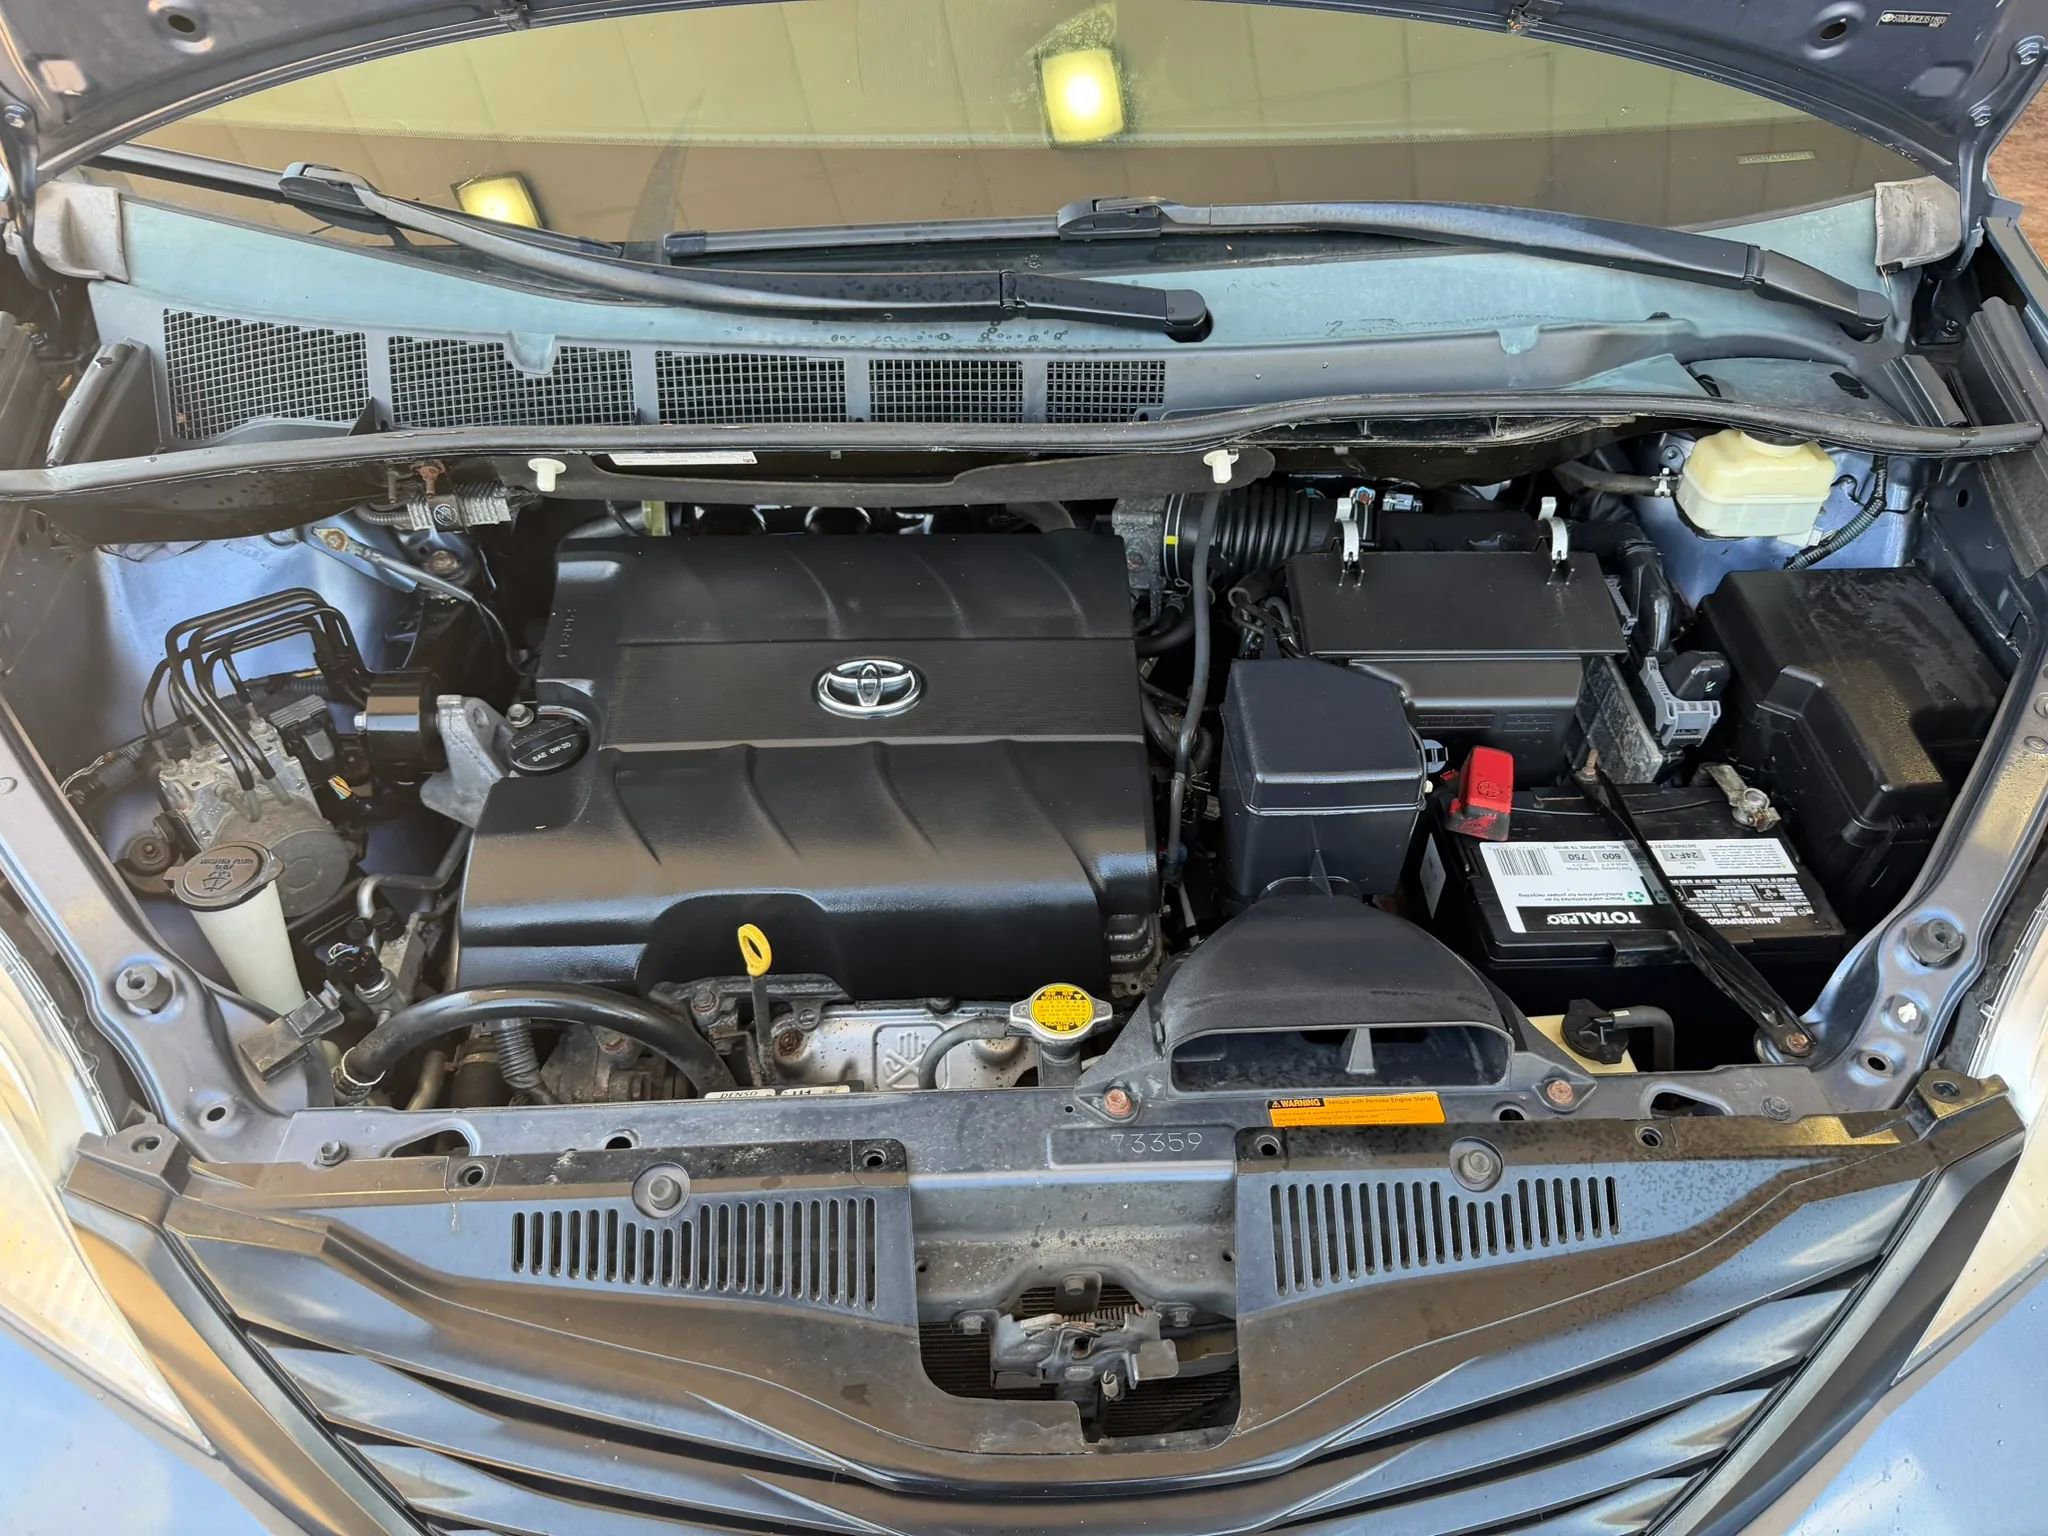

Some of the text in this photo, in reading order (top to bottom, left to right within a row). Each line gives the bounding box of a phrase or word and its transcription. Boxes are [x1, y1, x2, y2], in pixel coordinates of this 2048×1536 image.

[532, 742, 572, 762] SAE 0W-20
[1547, 911, 1641, 925] TOTALPRO
[1280, 1099, 1321, 1107] WARNING
[1391, 1096, 1412, 1104] Engine
[1110, 1132, 1203, 1153] 73359
